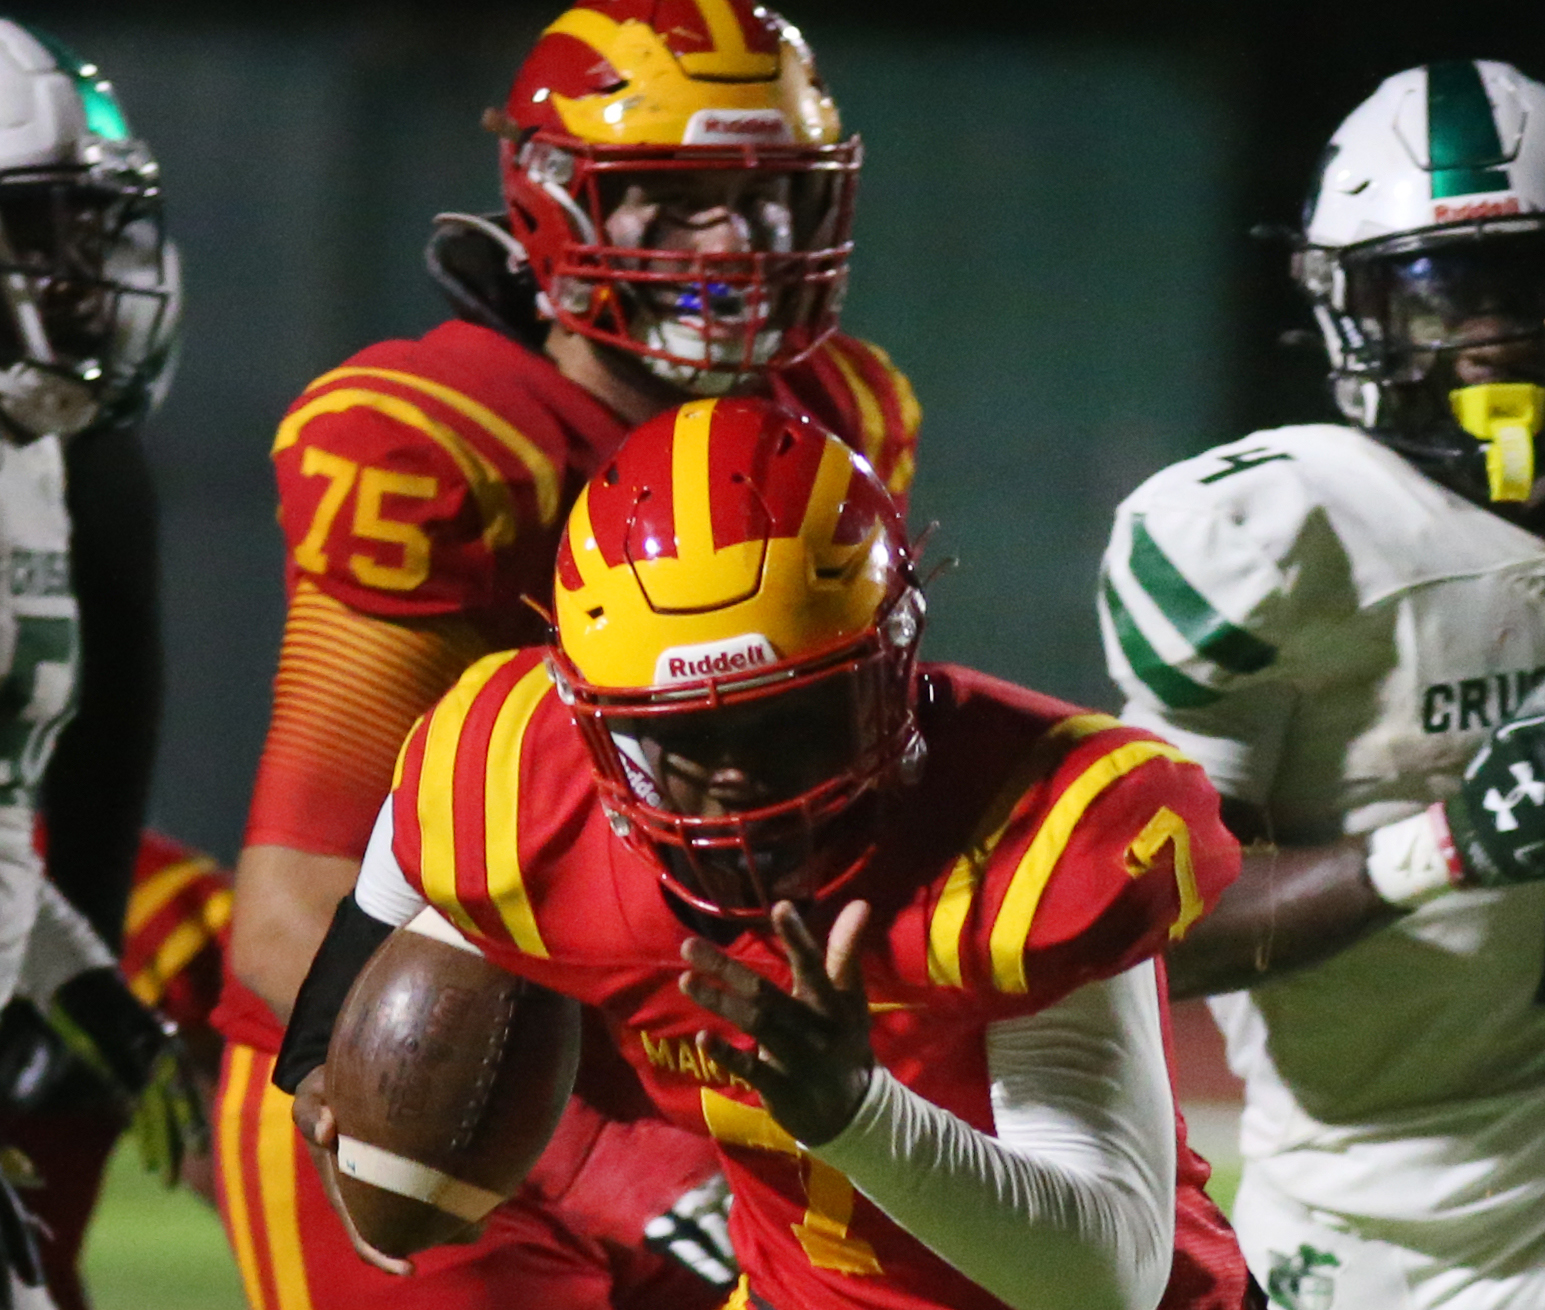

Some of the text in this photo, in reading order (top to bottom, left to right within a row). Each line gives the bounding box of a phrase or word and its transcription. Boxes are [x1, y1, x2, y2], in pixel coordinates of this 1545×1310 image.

[294, 446, 439, 591] 75
[668, 643, 768, 678] Riddell
[1123, 806, 1204, 941] 7
